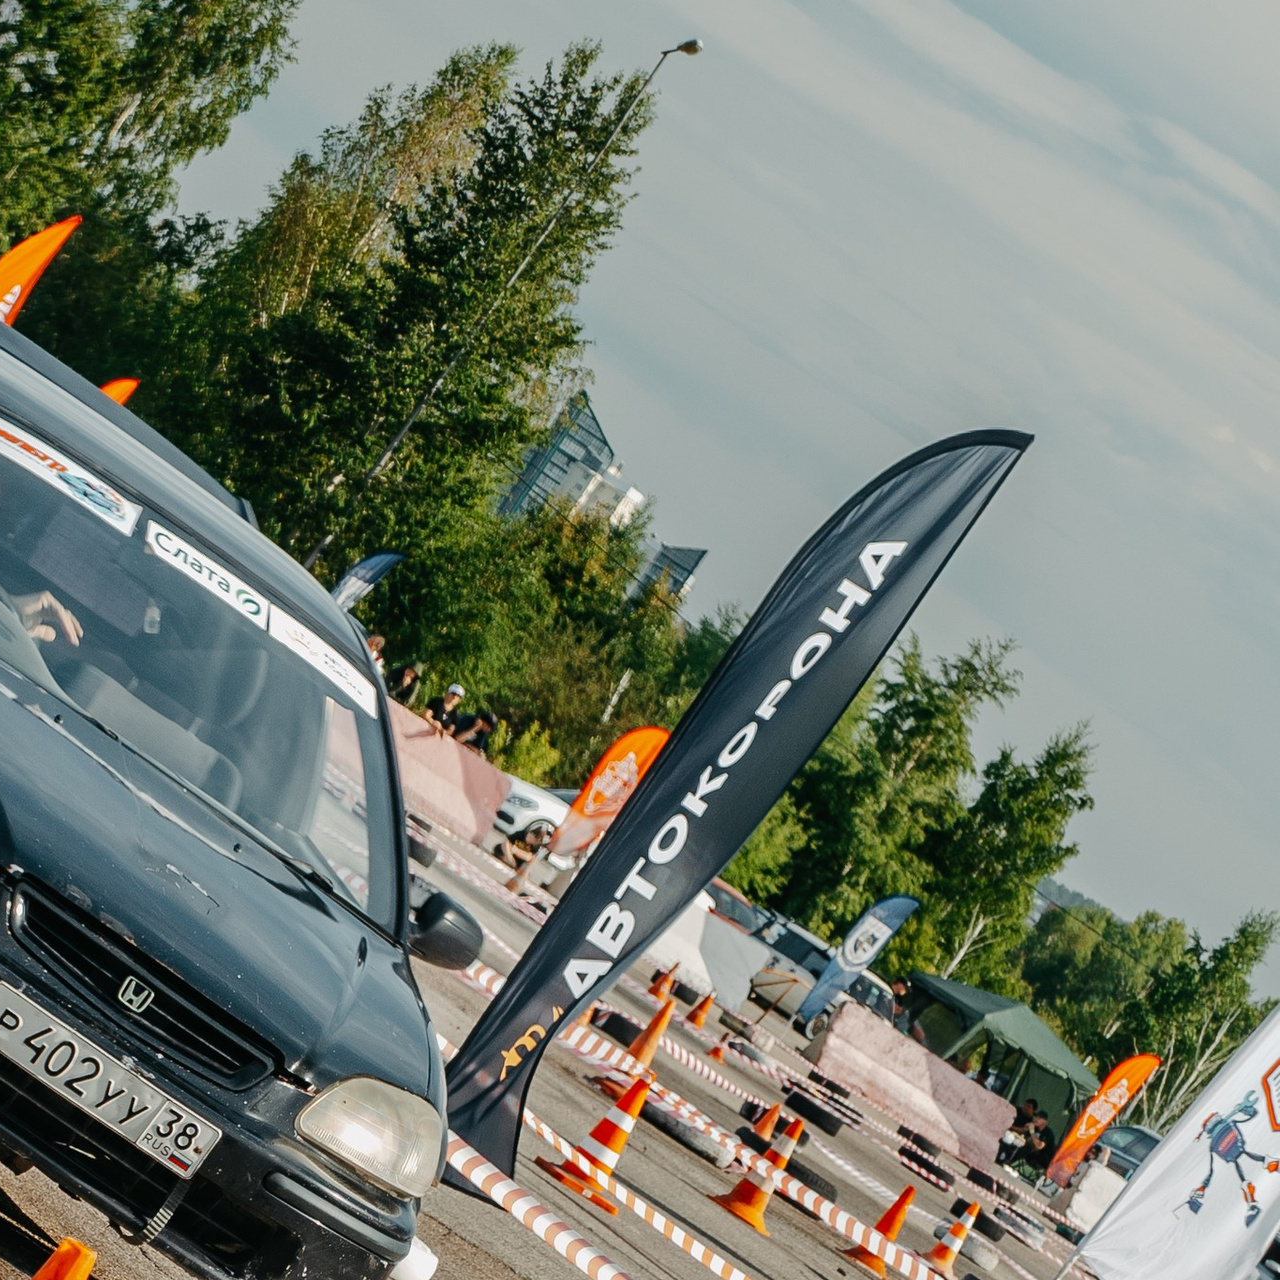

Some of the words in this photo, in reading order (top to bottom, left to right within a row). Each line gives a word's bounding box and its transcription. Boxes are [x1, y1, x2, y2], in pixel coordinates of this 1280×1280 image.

[154, 531, 232, 595] Слата
[563, 539, 910, 1000] АВТОКОРОНА
[142, 1131, 172, 1158] RUS
[155, 1107, 201, 1152] 38
